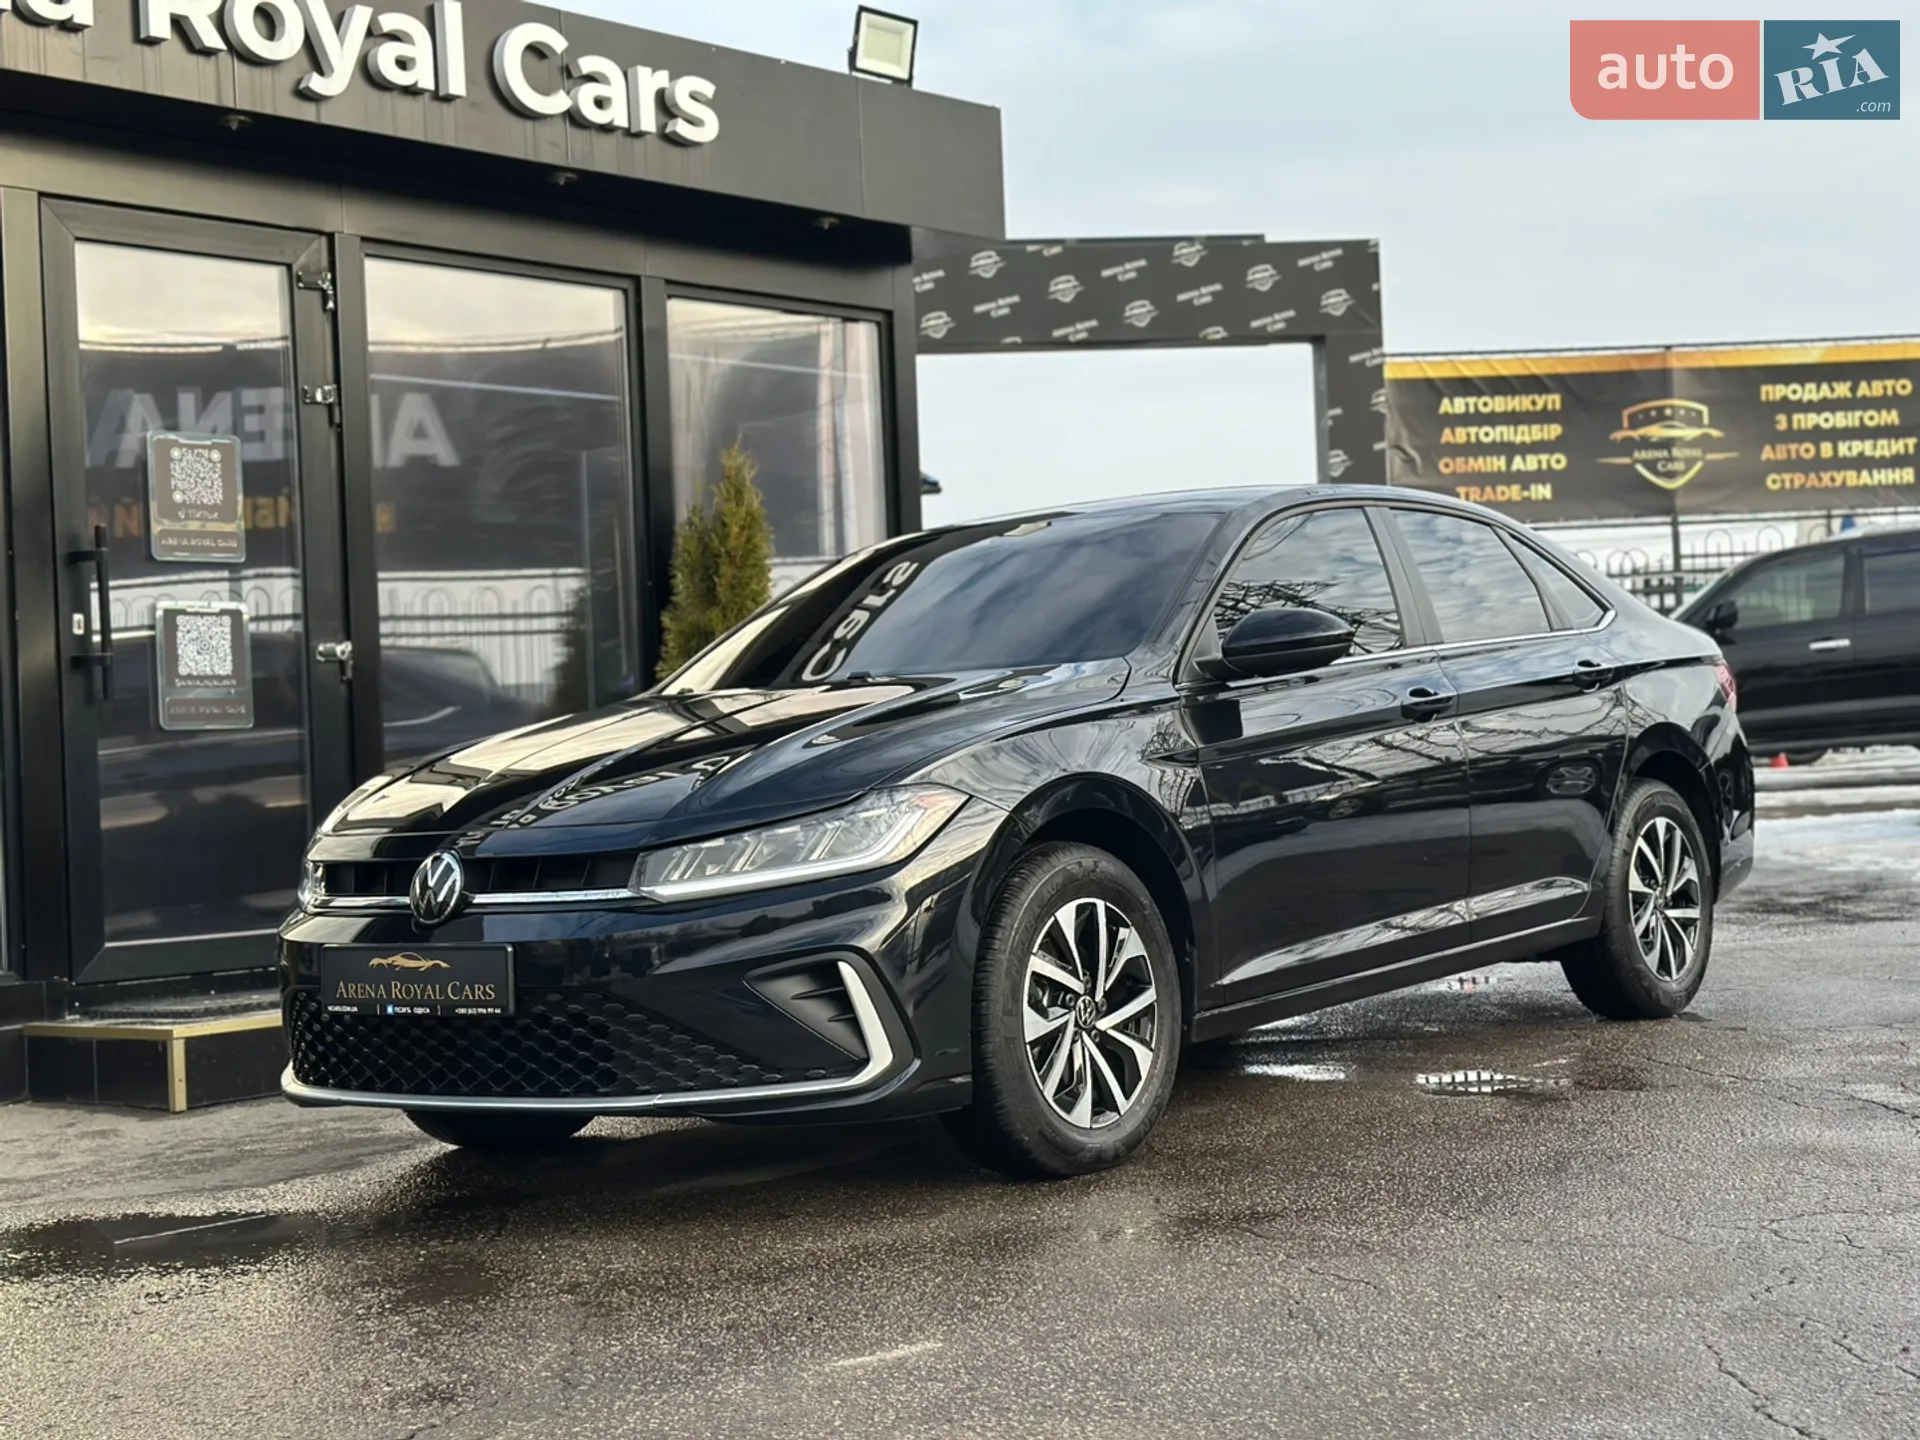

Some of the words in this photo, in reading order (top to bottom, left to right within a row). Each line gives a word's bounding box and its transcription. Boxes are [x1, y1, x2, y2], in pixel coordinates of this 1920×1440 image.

[492, 22, 720, 146] Cars
[1759, 381, 1853, 402] ПРОДАЖ
[1856, 378, 1913, 398] АВТО
[1438, 393, 1562, 415] АВТОВИКУП
[1792, 408, 1900, 431] ПРОБІГОМ
[1440, 423, 1563, 445] АВТОПІДБІР
[1760, 441, 1817, 462] АВТО
[1820, 440, 1834, 459] В
[1837, 437, 1918, 459] КРЕДИТ
[1438, 455, 1507, 475] ОБМІН
[1510, 452, 1568, 473] АВТО
[1766, 466, 1915, 491] СТРАХУВАННЯ
[1455, 483, 1553, 502] TRADE-IN
[336, 980, 387, 999] ARENA
[391, 981, 445, 1000] ROYAL
[447, 981, 496, 1000] CARS
